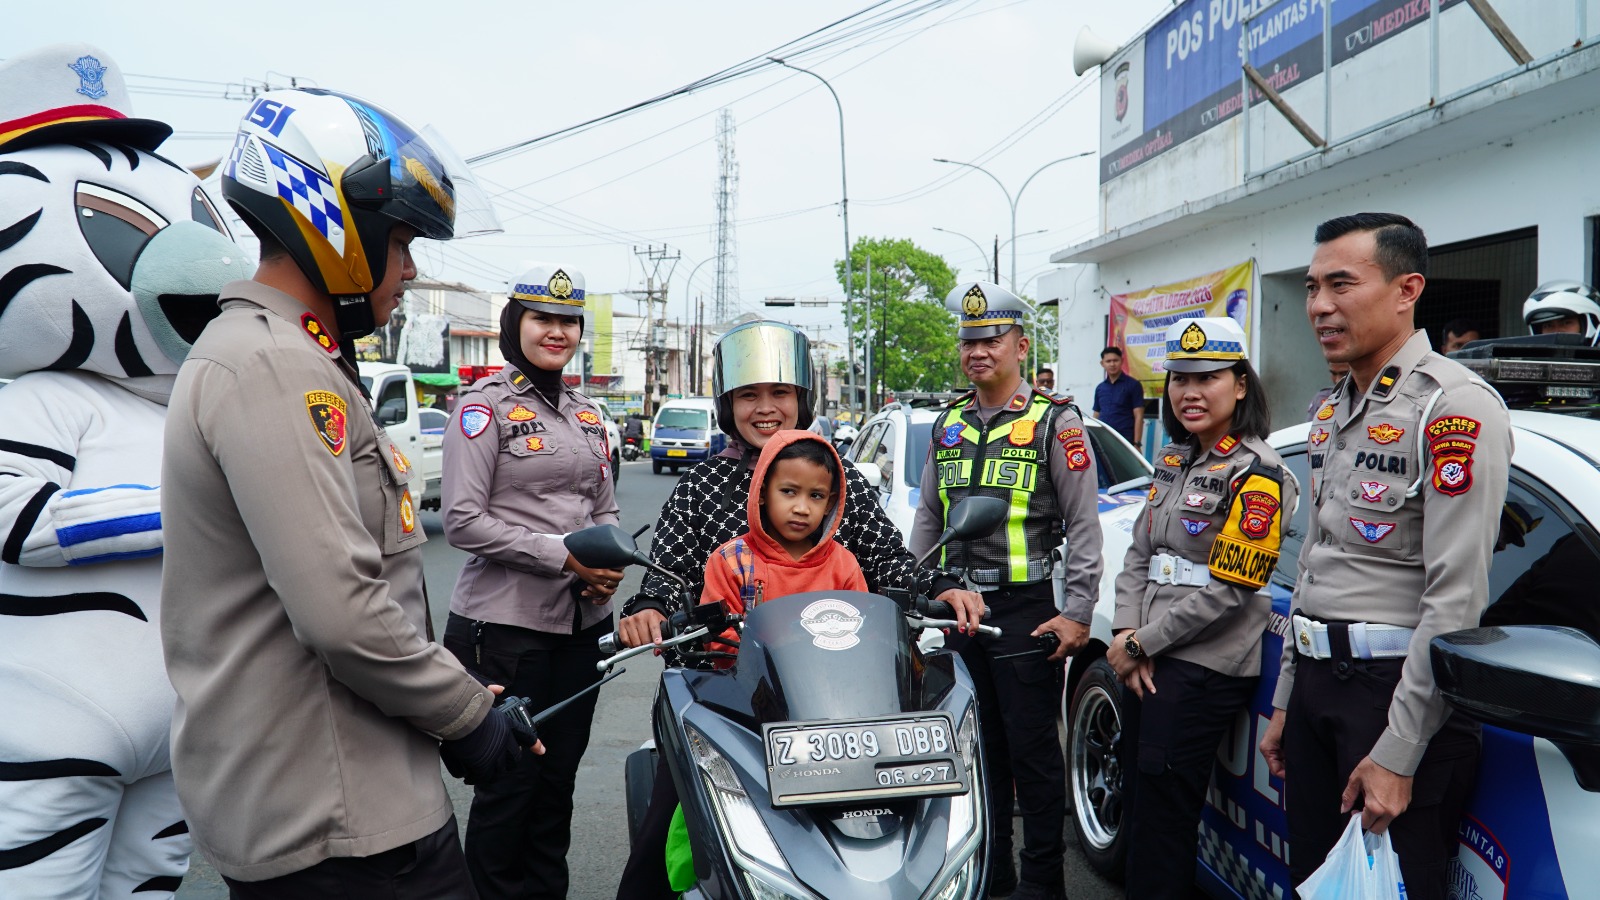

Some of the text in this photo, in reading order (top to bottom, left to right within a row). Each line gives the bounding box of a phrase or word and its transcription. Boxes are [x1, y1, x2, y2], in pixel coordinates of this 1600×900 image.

[1373, 0, 1430, 39] MEDIKA
[1166, 10, 1203, 70] POS
[309, 393, 346, 413] RESERSE
[511, 421, 547, 437] POPY
[1429, 418, 1476, 434] POLRES
[1434, 425, 1473, 435] GARUT
[1003, 449, 1036, 459] POLRI
[1355, 451, 1407, 475] POLRI
[987, 461, 1034, 489] ISI
[1189, 475, 1224, 493] POLRI
[776, 725, 948, 765] Z 3089 DBB
[793, 767, 841, 778] HONDA
[842, 808, 894, 819] HONDA
[1458, 821, 1504, 869] LINTAS
